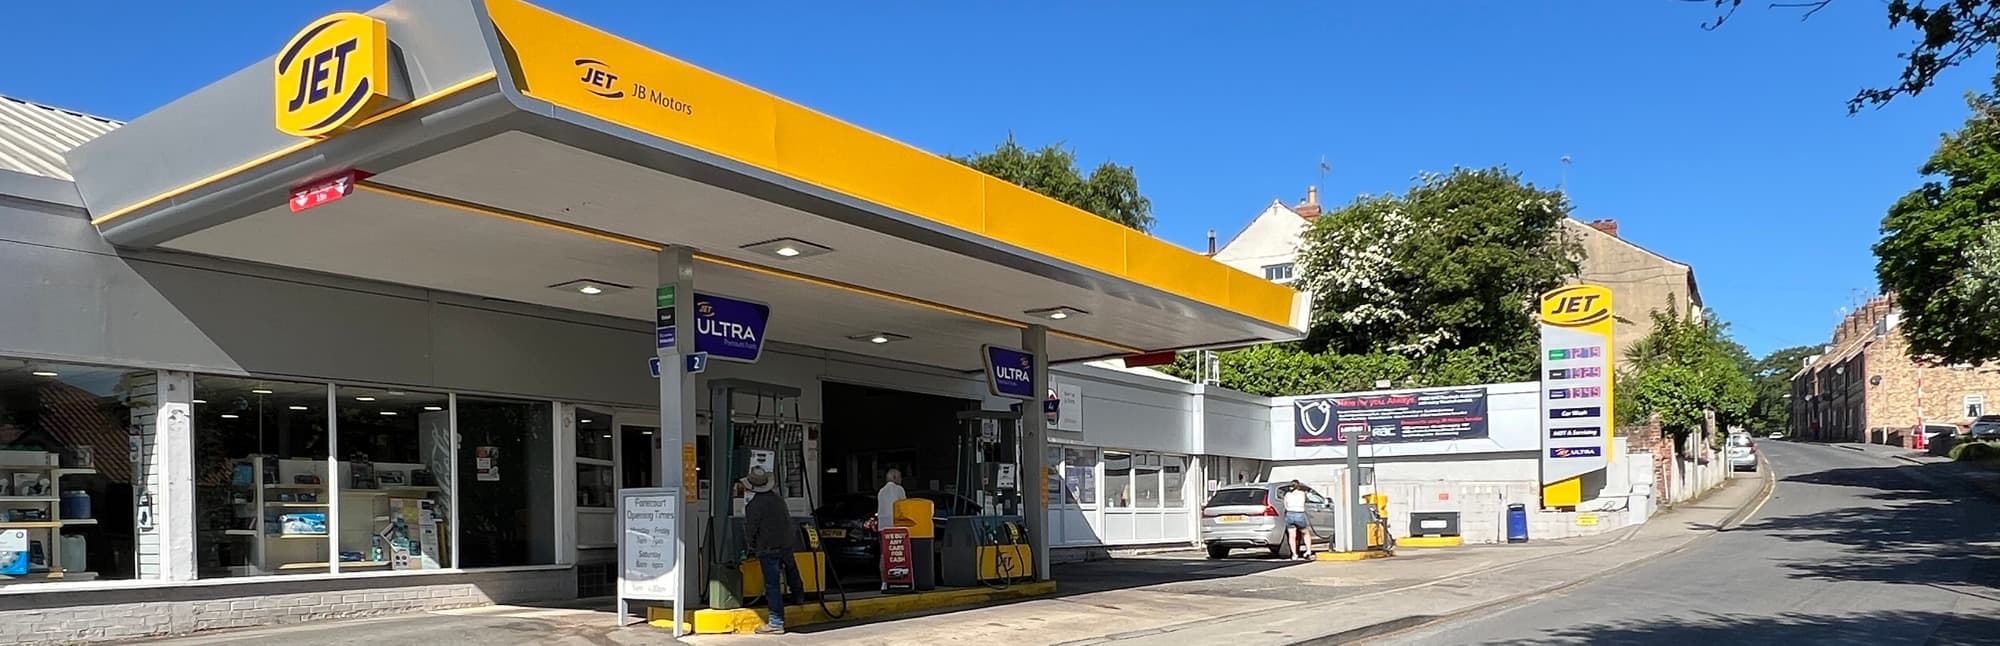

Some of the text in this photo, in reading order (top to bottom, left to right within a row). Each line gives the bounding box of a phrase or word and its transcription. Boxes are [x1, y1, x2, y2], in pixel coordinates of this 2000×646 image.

[289, 38, 357, 112] JET
[581, 67, 618, 89] JET
[632, 83, 693, 115] JB Motors
[1551, 295, 1600, 315] JET
[697, 318, 756, 342] ULTRA
[693, 357, 700, 369] 2
[996, 366, 1030, 382] ULTRA
[1573, 429, 1597, 437] Servicing
[635, 498, 666, 507] Forecourt
[627, 510, 674, 521] Opening Times
[638, 550, 662, 559] Saturday
